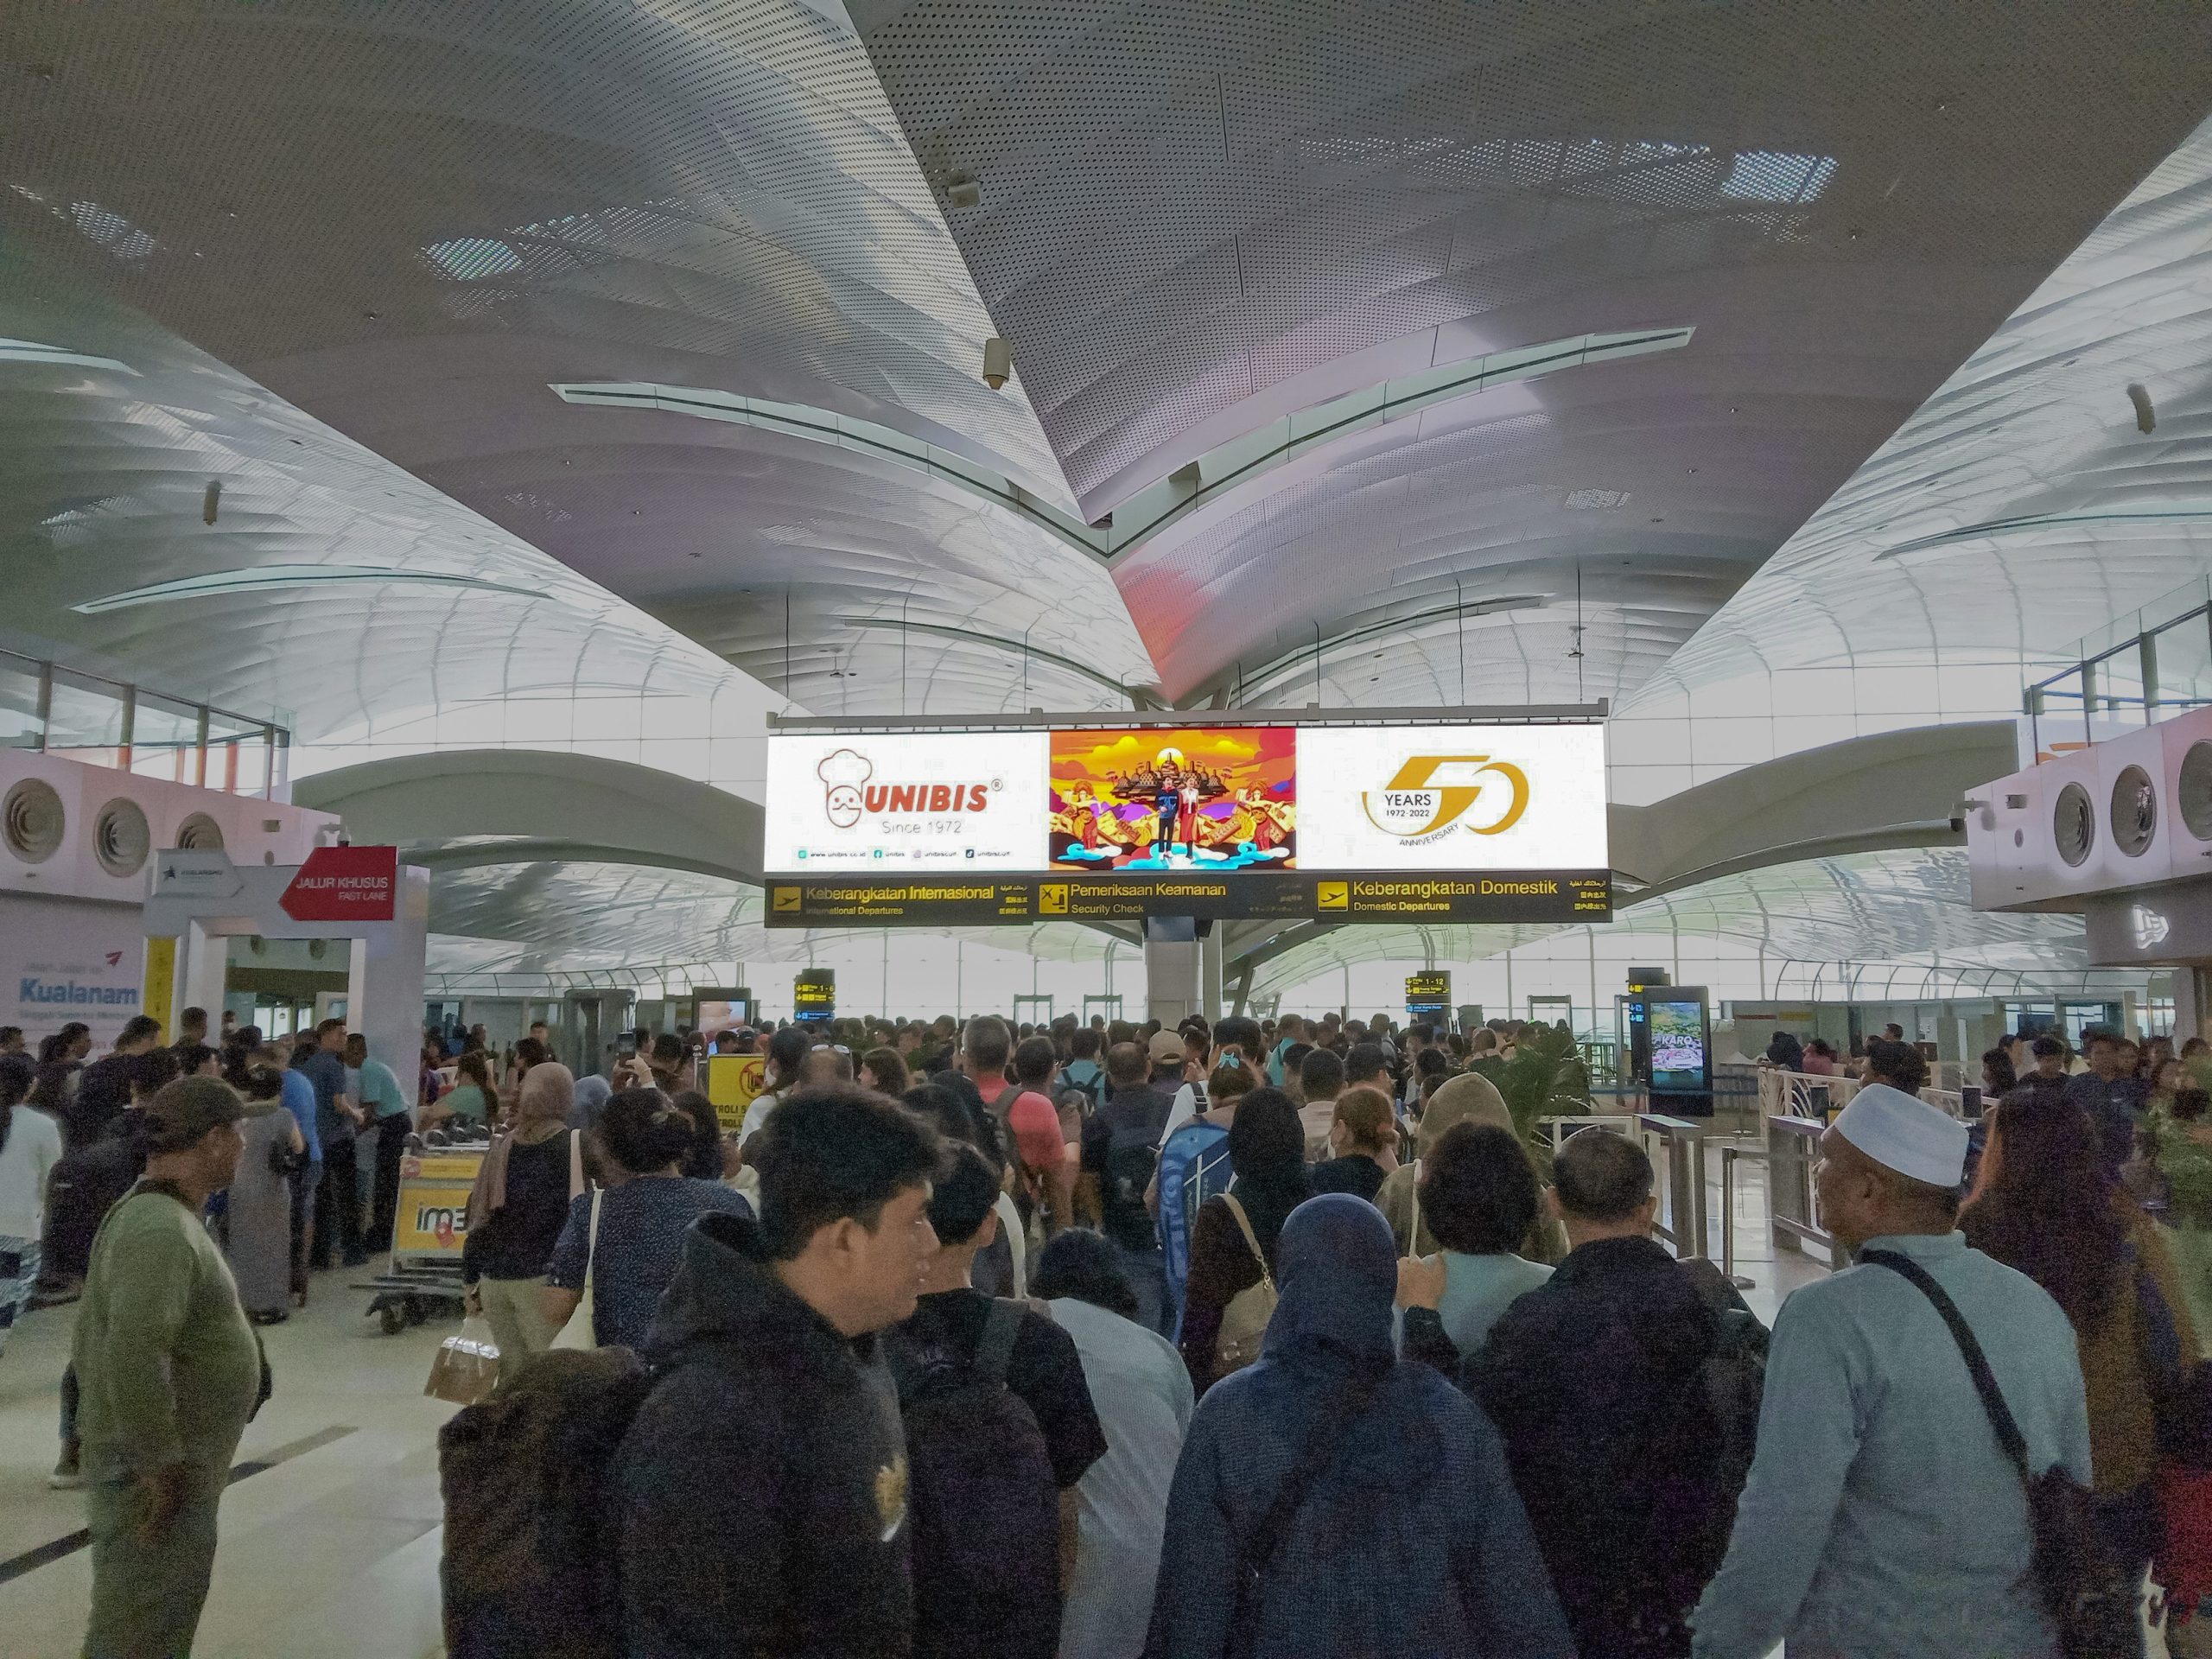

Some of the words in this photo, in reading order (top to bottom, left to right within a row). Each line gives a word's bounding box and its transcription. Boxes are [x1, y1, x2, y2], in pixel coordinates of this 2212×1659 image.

[865, 785, 988, 812] UNIBIS
[1385, 794, 1431, 806] YEARS
[882, 822, 921, 833] Since
[927, 821, 961, 833] 1972
[1399, 823, 1459, 847] ANNIVERSARY
[296, 877, 335, 888] JALUR
[338, 876, 388, 888] KHUSUS
[806, 887, 906, 904] Keberangkatan
[910, 886, 995, 899] Internasional
[1071, 884, 1153, 897] Pemeriksaan
[1156, 883, 1226, 896] Keamanan
[1353, 880, 1475, 899] Keberangkatan
[1481, 880, 1558, 895] Domestik
[339, 892, 362, 900] FAST
[364, 892, 387, 900] LANE
[858, 906, 904, 916] Departures
[1071, 904, 1110, 915] Security
[1113, 904, 1144, 913] Check
[1354, 902, 1397, 911] Domestic
[1399, 902, 1451, 912] Departures
[1662, 1036, 1693, 1045] KARO
